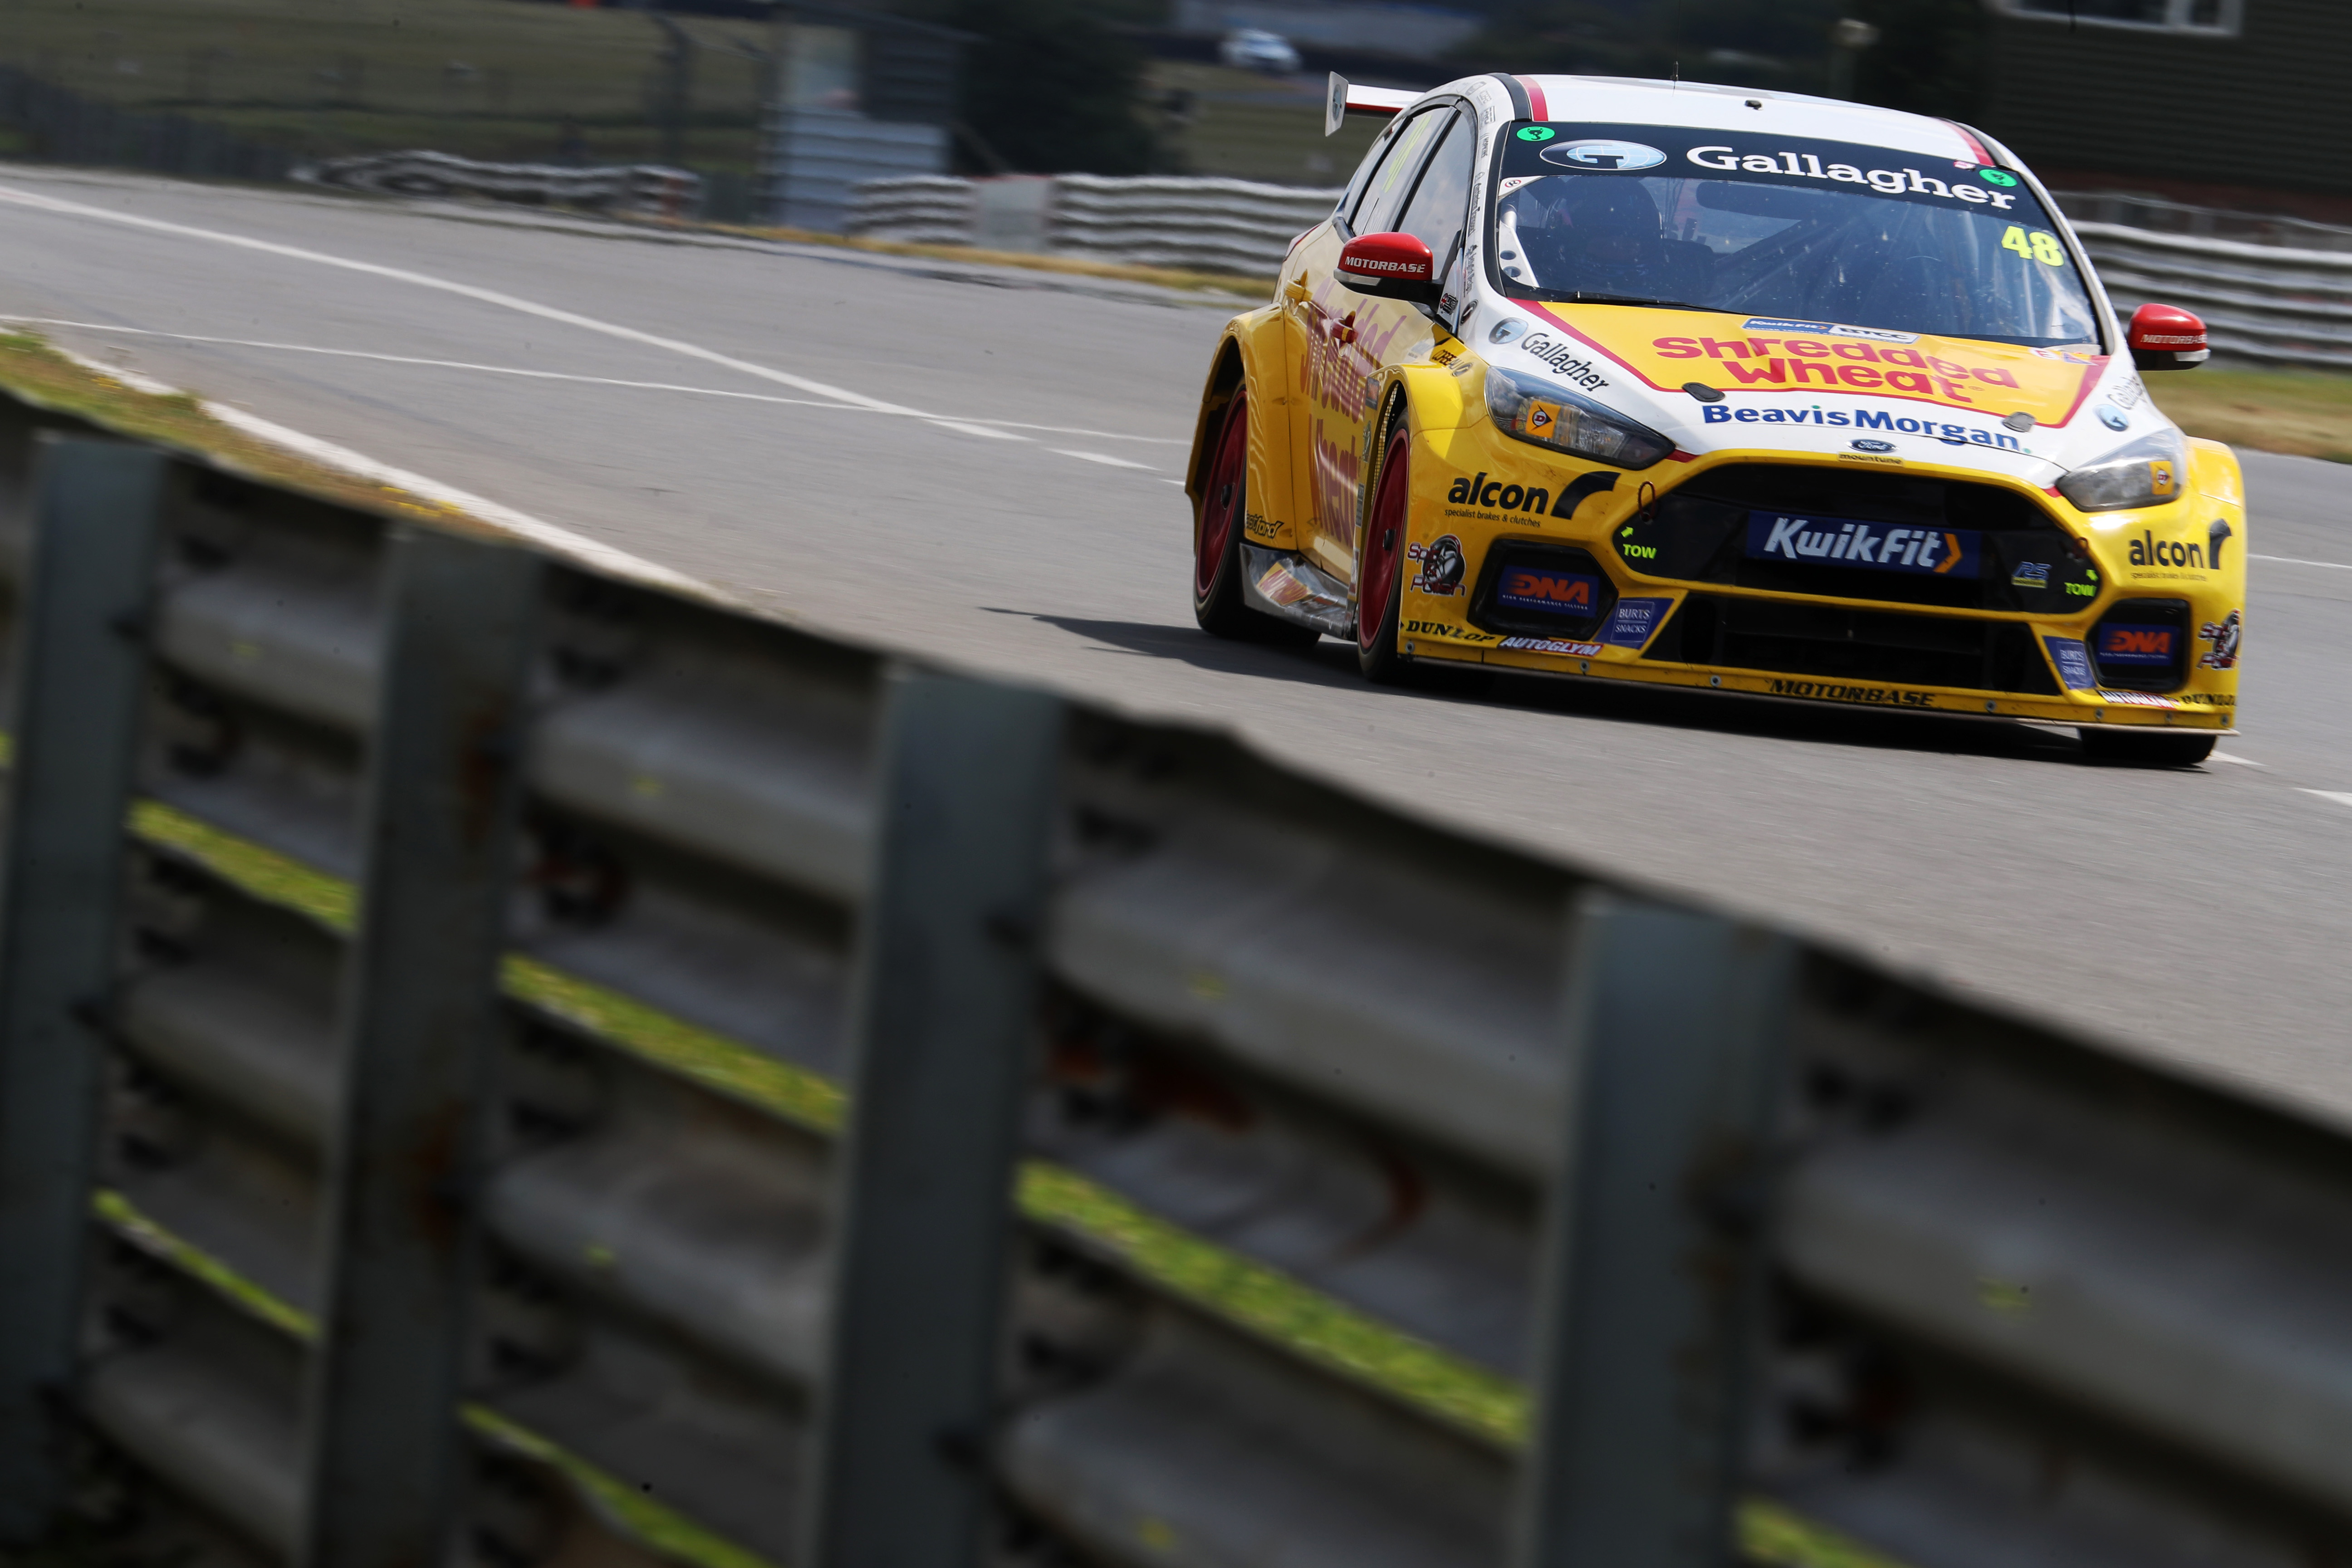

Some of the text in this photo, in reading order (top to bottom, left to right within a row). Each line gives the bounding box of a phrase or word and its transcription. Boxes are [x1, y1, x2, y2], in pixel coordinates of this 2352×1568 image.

[1686, 146, 2016, 210] Gallagher
[2001, 225, 2064, 267] 48
[1345, 256, 1426, 273] MOTORBASE
[1521, 333, 1610, 392] Gallagher
[1839, 454, 1901, 464] mountune
[1447, 472, 1549, 514] alcon
[1445, 508, 1475, 518] specialist
[1477, 510, 1500, 521] brakes
[1510, 515, 1541, 527] clutches
[1622, 544, 1657, 559] TOW
[2129, 529, 2204, 568] alcon
[2012, 561, 2053, 580] RS
[1506, 574, 1589, 604] DNA
[1618, 609, 1651, 620] BURTS
[1406, 620, 1496, 642] DUNLOP
[1615, 624, 1646, 634] SNACKS
[1499, 636, 1601, 656] AUTOGLYM
[1770, 679, 1936, 706] MOTORBASE
